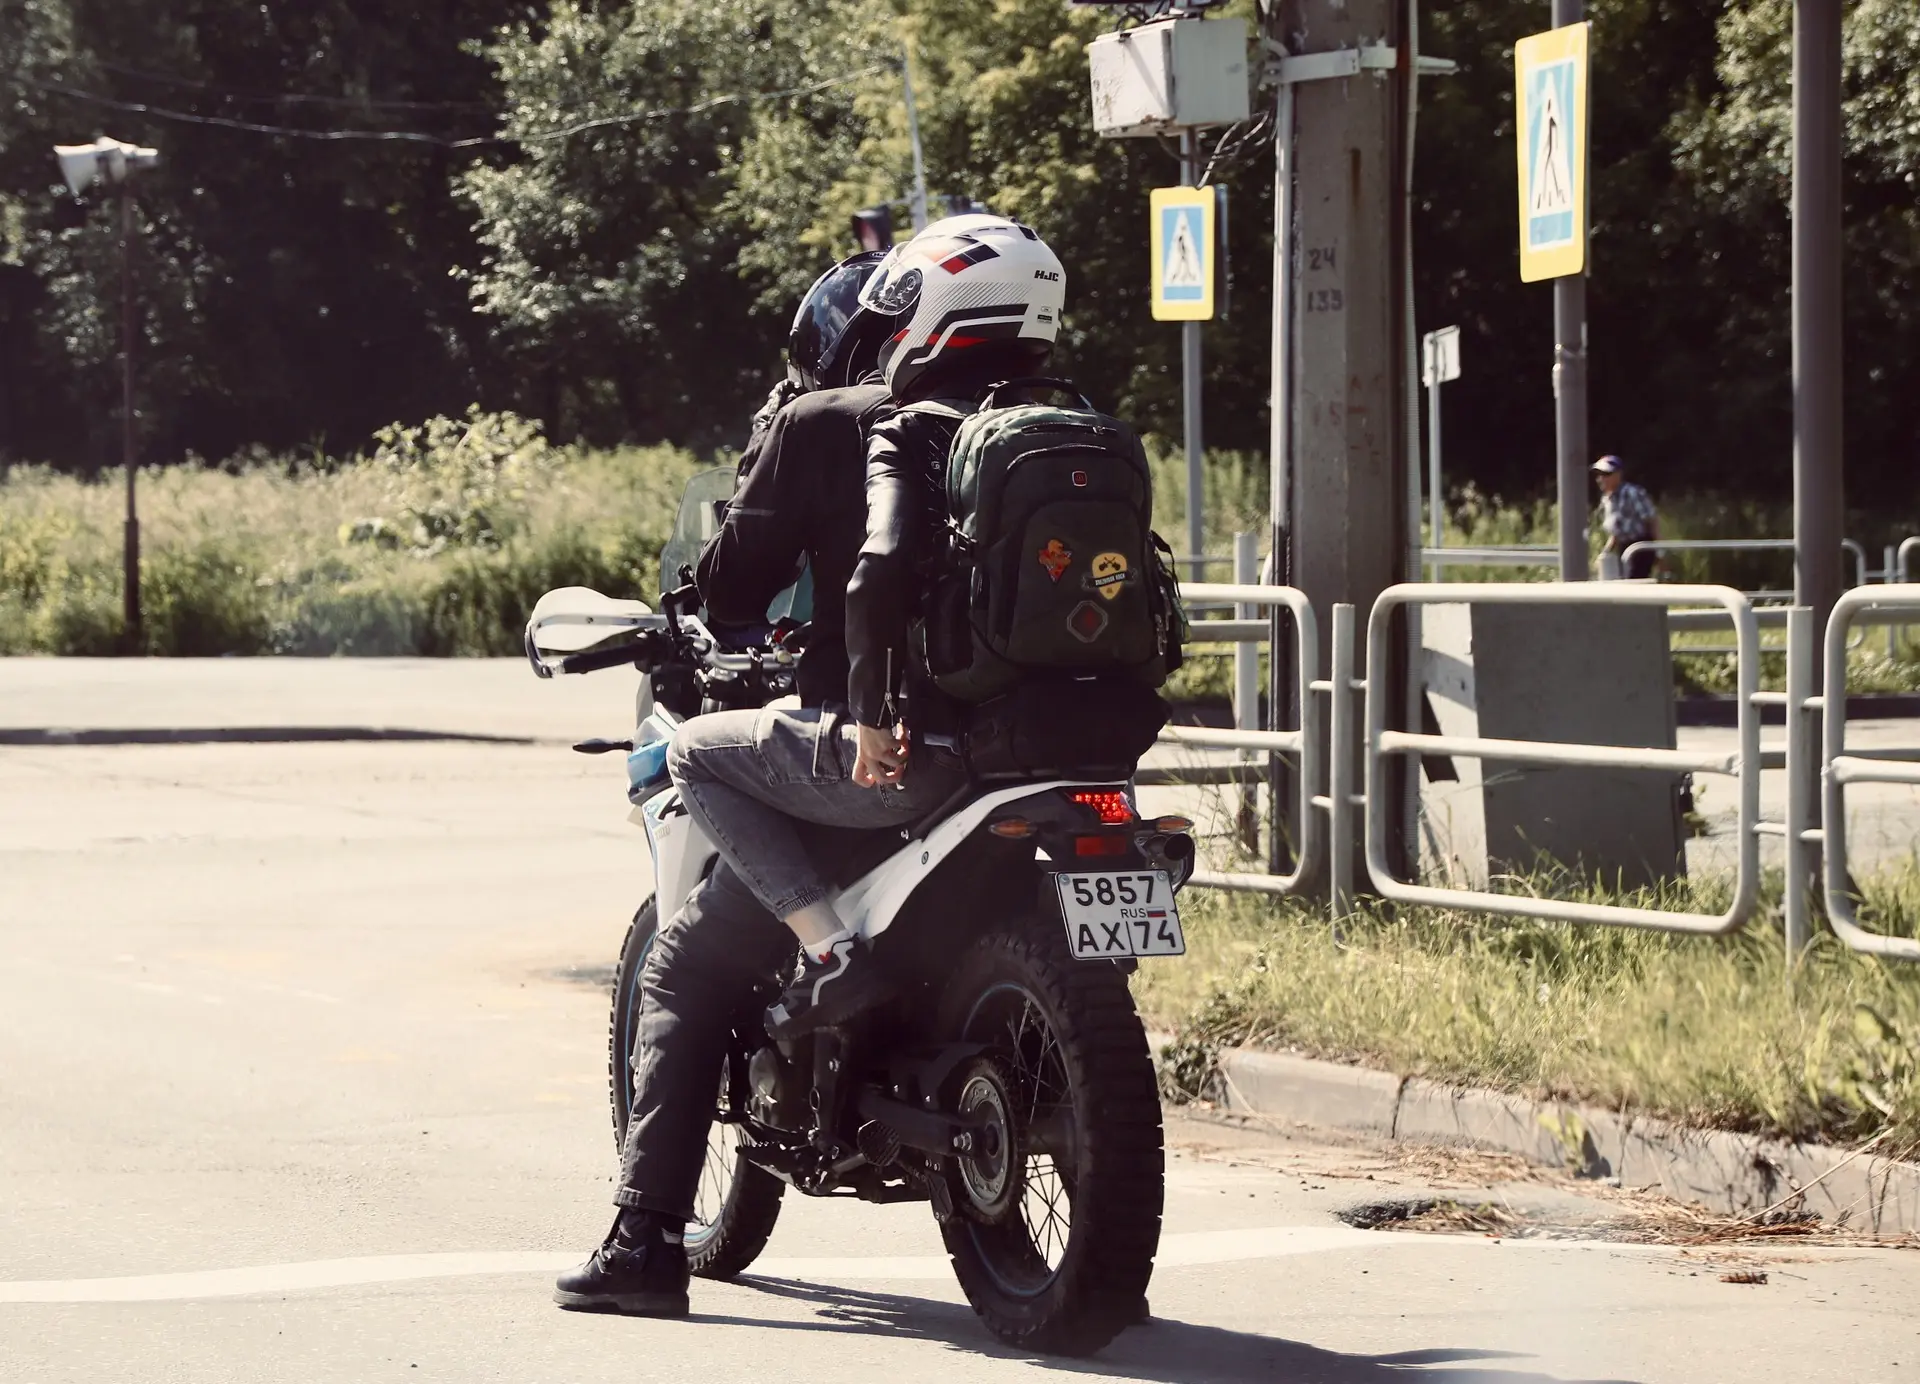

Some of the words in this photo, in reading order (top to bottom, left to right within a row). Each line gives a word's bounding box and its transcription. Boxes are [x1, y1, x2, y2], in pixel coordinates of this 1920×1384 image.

[1308, 247, 1336, 270] 24
[1034, 270, 1059, 281] HJC
[1072, 875, 1154, 906] 5857
[1120, 908, 1147, 918] RUS
[1078, 922, 1126, 952] AX
[1133, 920, 1176, 949] 74
